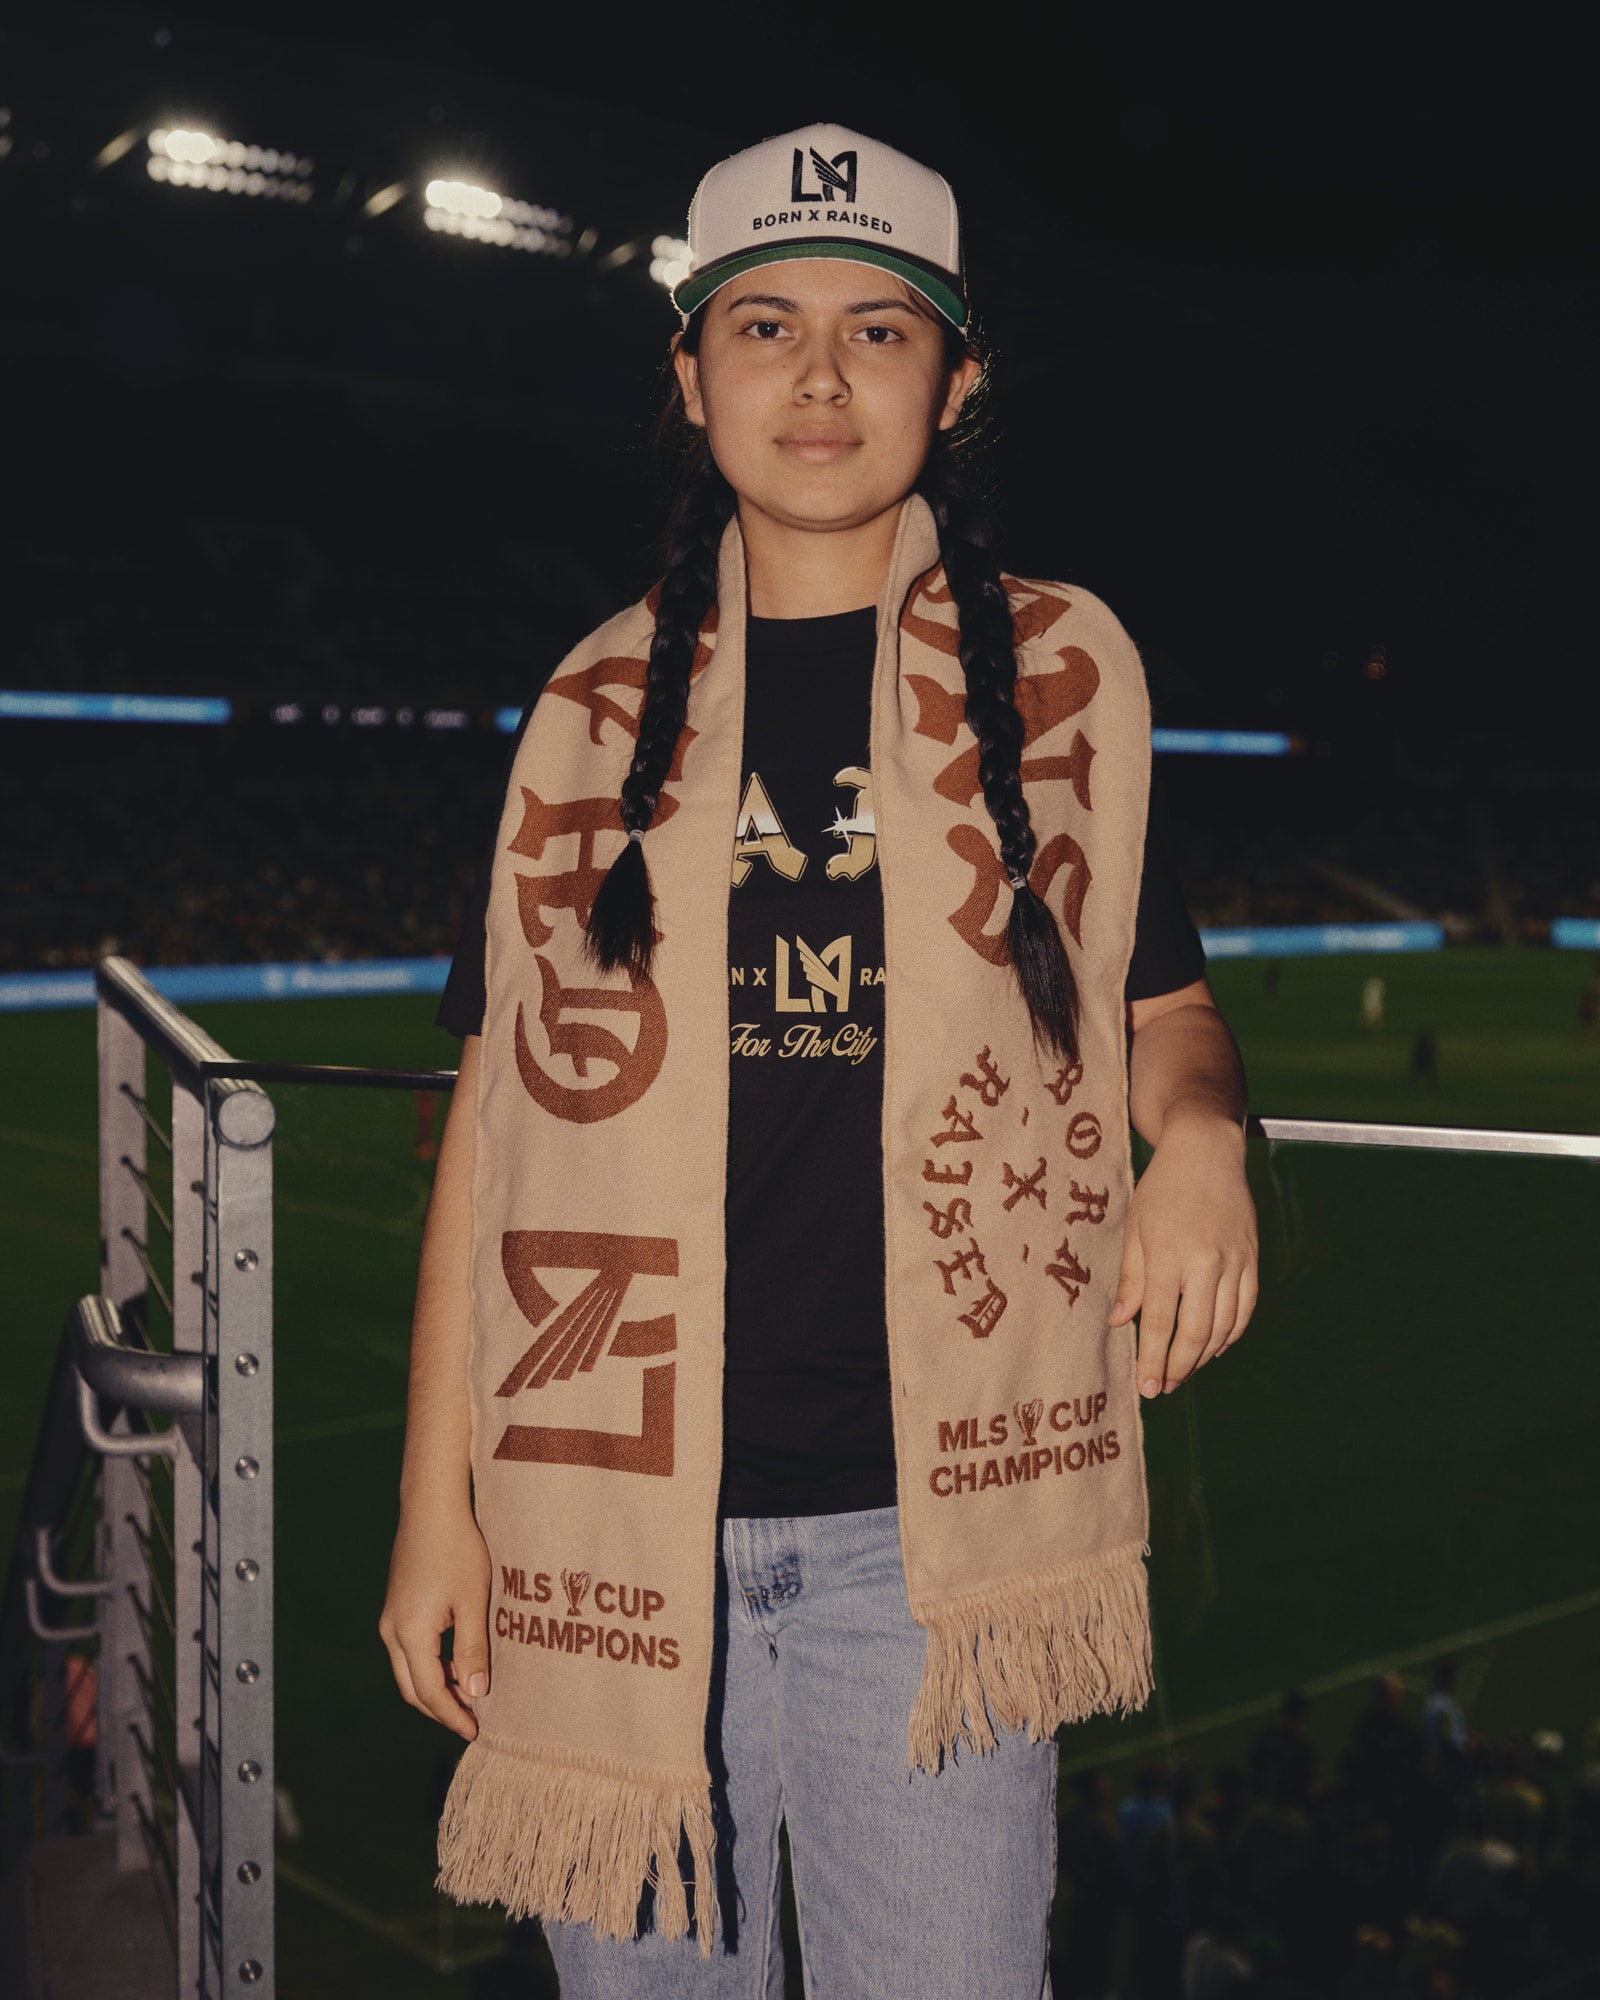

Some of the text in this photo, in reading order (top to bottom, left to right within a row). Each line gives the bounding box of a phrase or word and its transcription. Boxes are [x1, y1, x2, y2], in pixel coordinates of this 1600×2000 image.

[752, 209, 893, 235] BORN X RAISED
[752, 967, 768, 986] X
[731, 1023, 878, 1066] For The City
[921, 1044, 1010, 1340] RAISED
[938, 1391, 1107, 1453] MLS CUP
[929, 1430, 1121, 1497] CHAMPIONS
[501, 1565, 665, 1621] MLS CUP
[495, 1606, 681, 1670] CHAMPIONS
